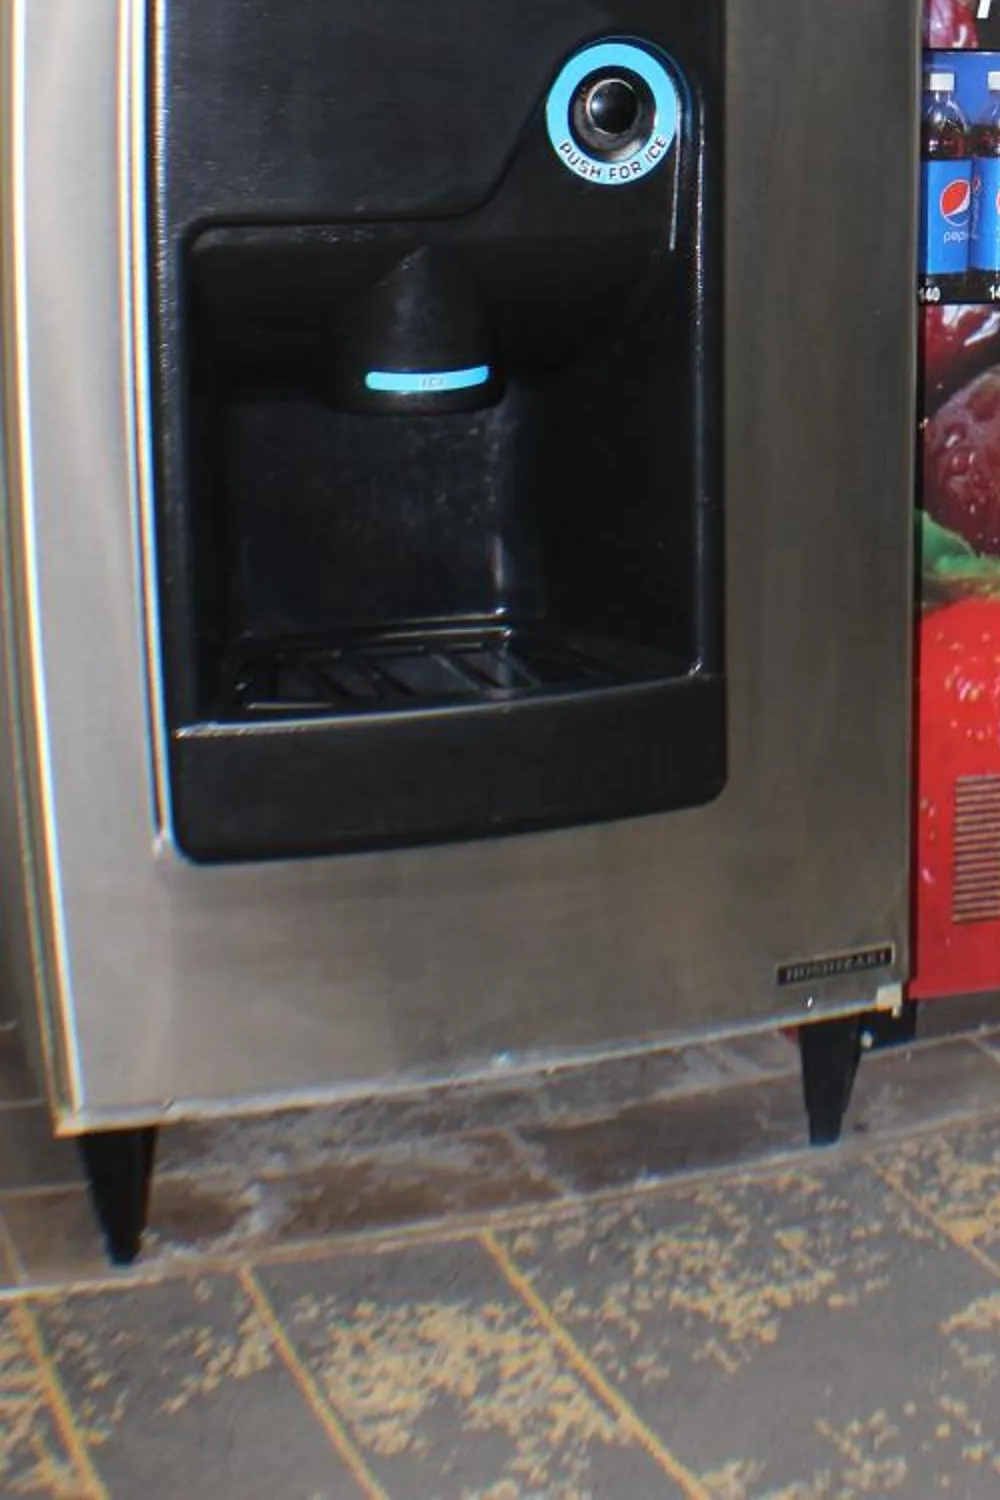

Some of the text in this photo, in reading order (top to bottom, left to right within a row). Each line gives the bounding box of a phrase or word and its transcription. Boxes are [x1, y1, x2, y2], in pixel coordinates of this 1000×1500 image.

[559, 137, 667, 180] PUSH FOR ICE
